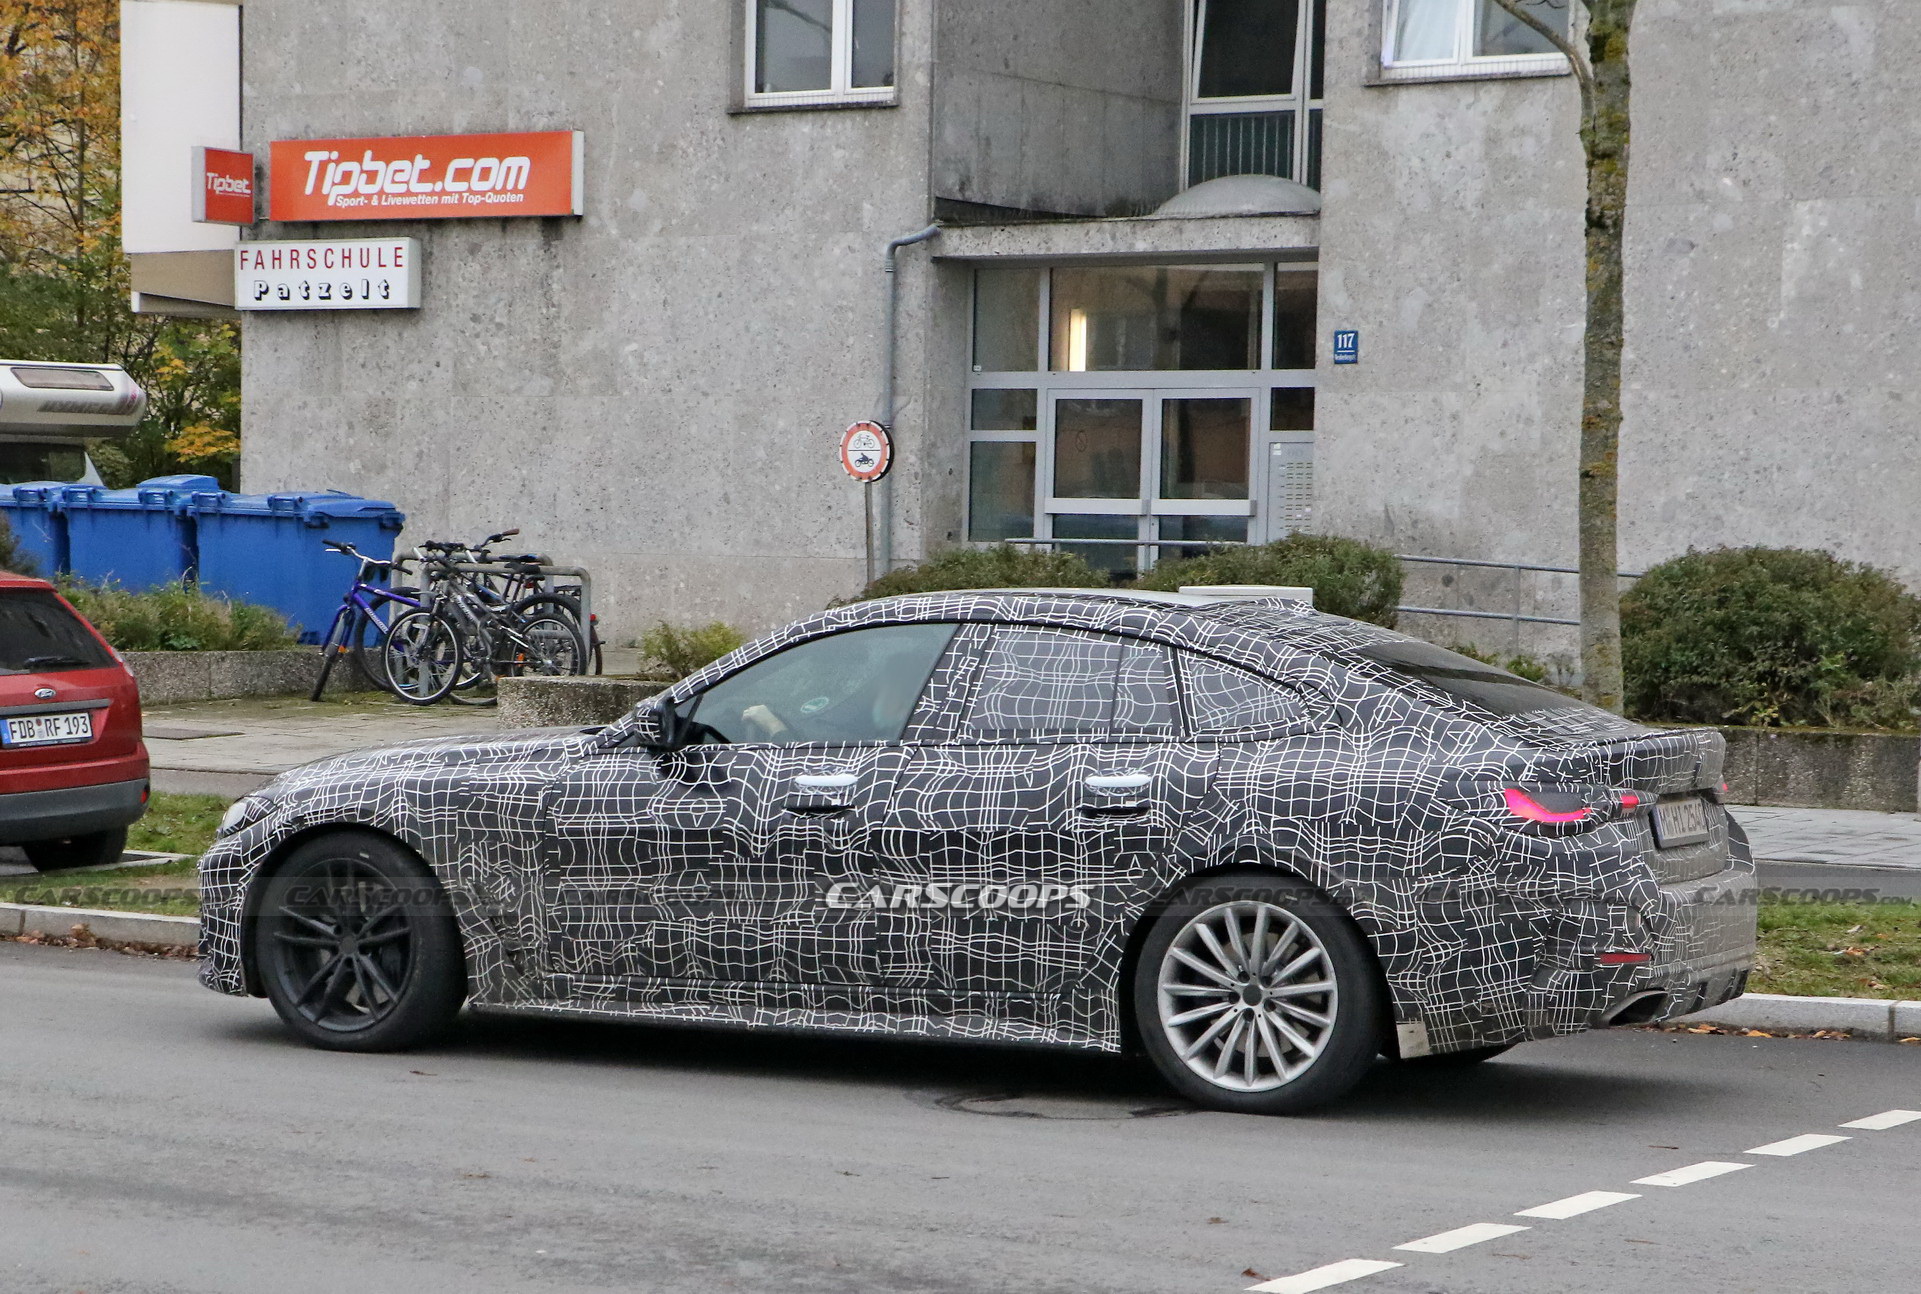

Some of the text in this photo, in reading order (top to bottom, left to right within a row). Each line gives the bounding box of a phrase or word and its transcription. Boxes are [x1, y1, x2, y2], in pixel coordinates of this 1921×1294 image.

[304, 150, 531, 206] Tipbet.com
[336, 191, 524, 208] Sport- & Livewetten mit Top-Quoten
[240, 247, 403, 270] FAHRSCHULE
[253, 279, 390, 301] Patzelt
[1337, 333, 1355, 348] 117
[9, 715, 89, 740] FDB RF 193
